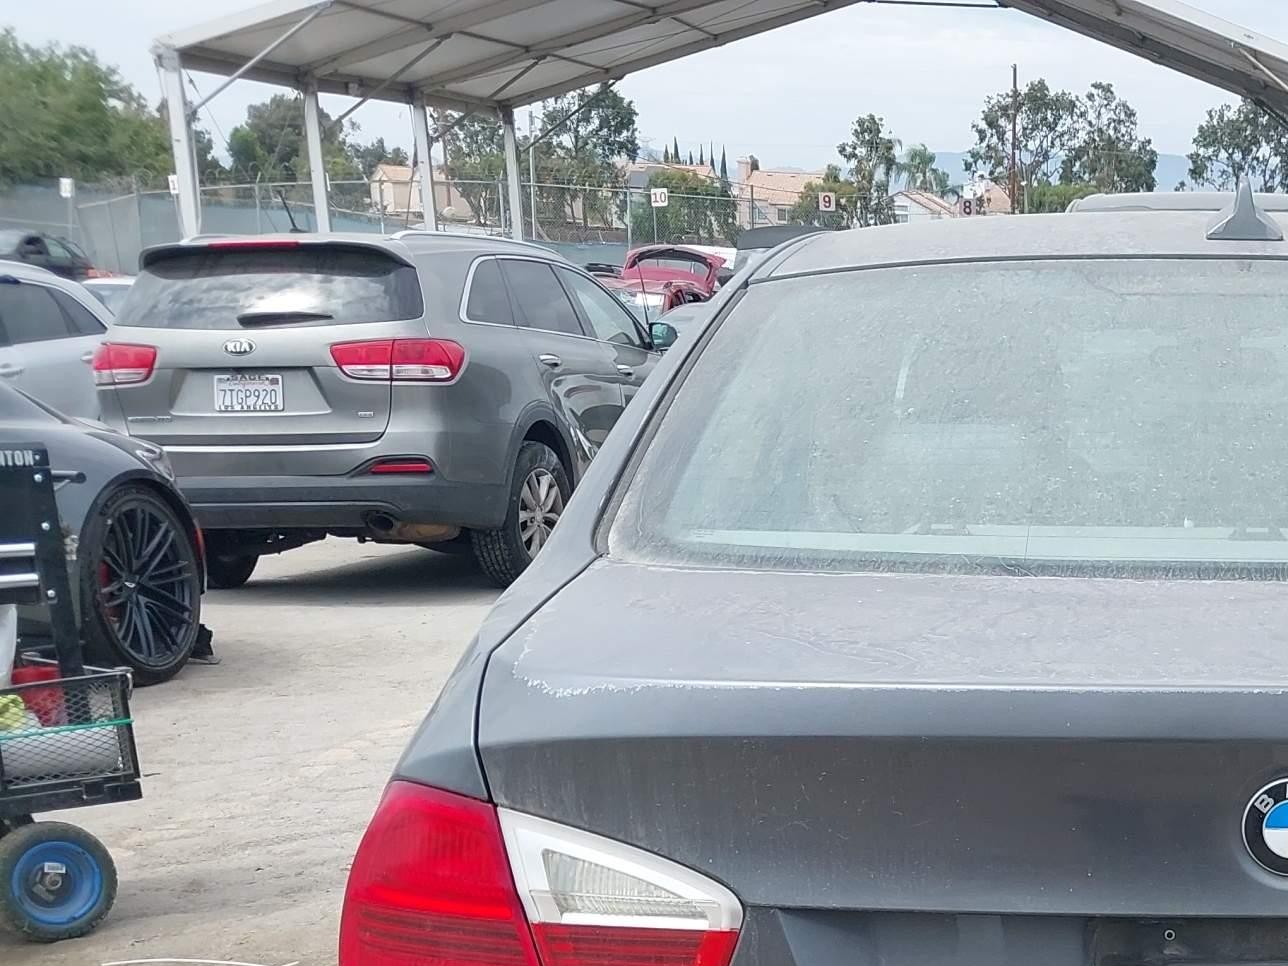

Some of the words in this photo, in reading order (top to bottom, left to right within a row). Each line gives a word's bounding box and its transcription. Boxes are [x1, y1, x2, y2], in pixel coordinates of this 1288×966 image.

[651, 191, 667, 203] 10
[823, 195, 831, 208] 9
[963, 200, 972, 215] 8
[226, 341, 251, 352] KIA
[219, 389, 277, 405] 7TGP920
